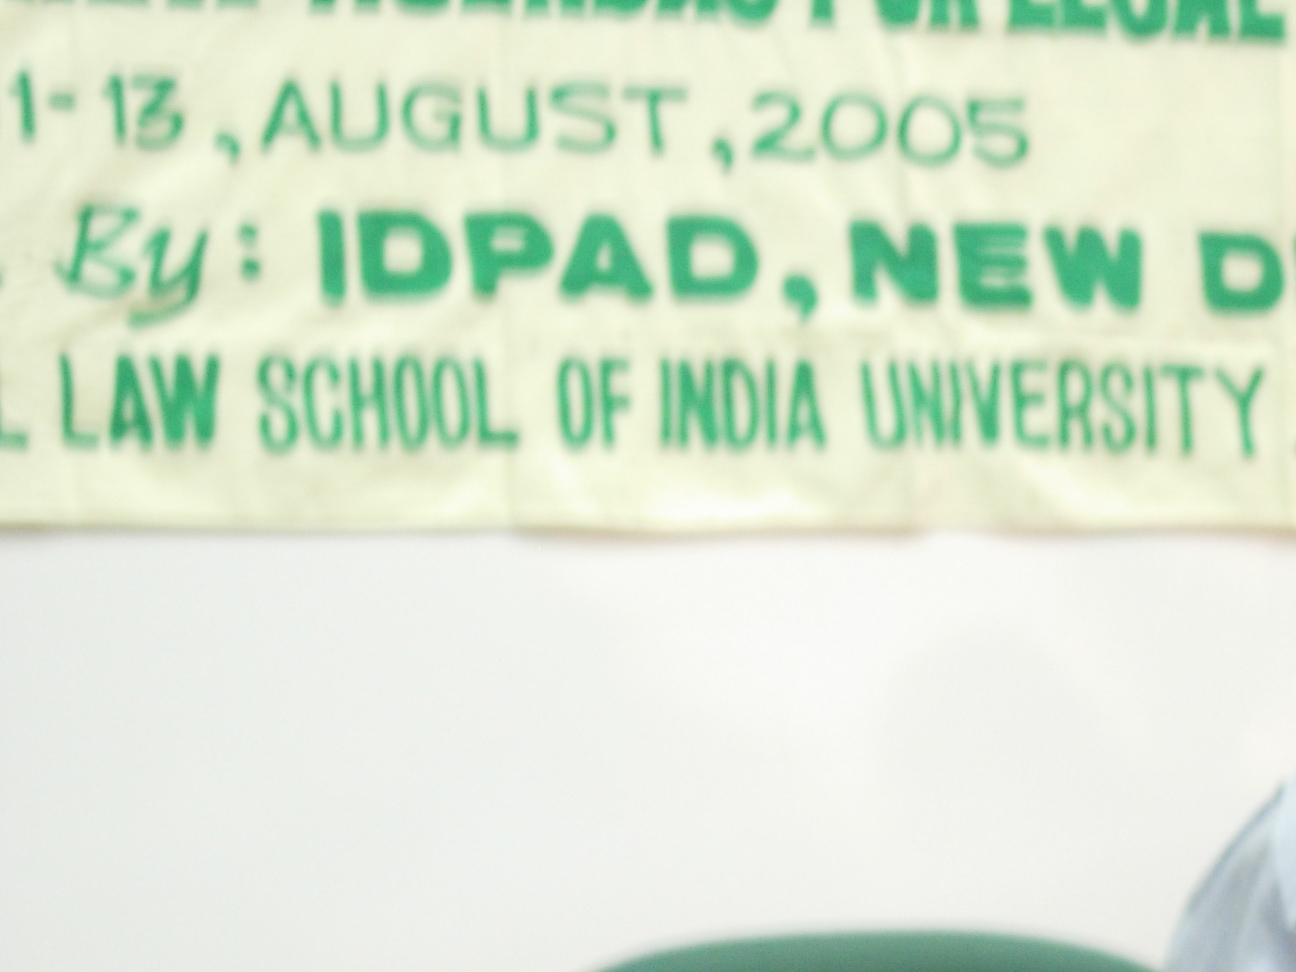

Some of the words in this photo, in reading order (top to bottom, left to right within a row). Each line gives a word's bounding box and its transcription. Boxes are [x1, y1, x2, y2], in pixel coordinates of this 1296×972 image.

[846, 217, 1146, 312] NEW
[57, 352, 222, 450] LAW
[254, 354, 521, 452] SCHOOL
[554, 356, 631, 450] OF
[657, 357, 828, 452] INDIA
